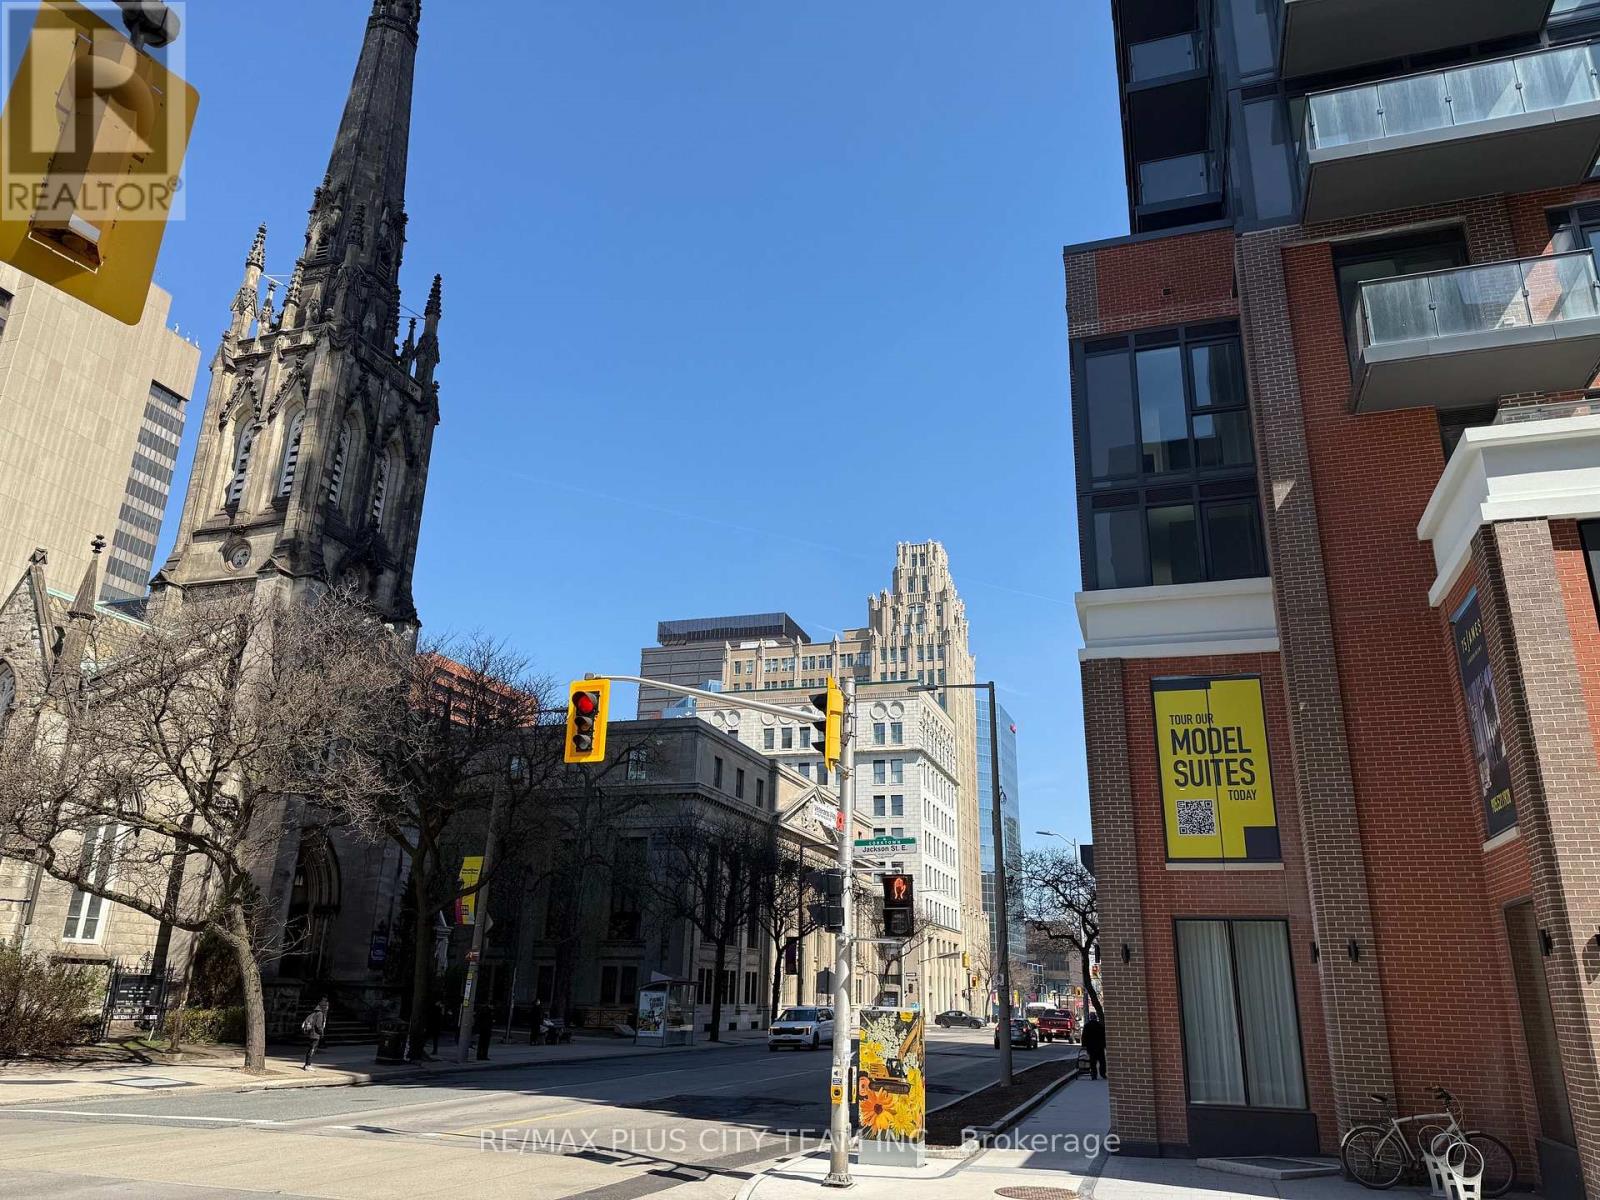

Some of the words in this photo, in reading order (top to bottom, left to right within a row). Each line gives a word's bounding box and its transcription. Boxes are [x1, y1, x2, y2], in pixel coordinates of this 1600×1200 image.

[1169, 714, 1193, 725] TOUR
[1195, 713, 1214, 724] OUR
[1170, 726, 1252, 755] MODEL
[1173, 757, 1256, 787] SUITES
[1228, 789, 1257, 800] TODAY
